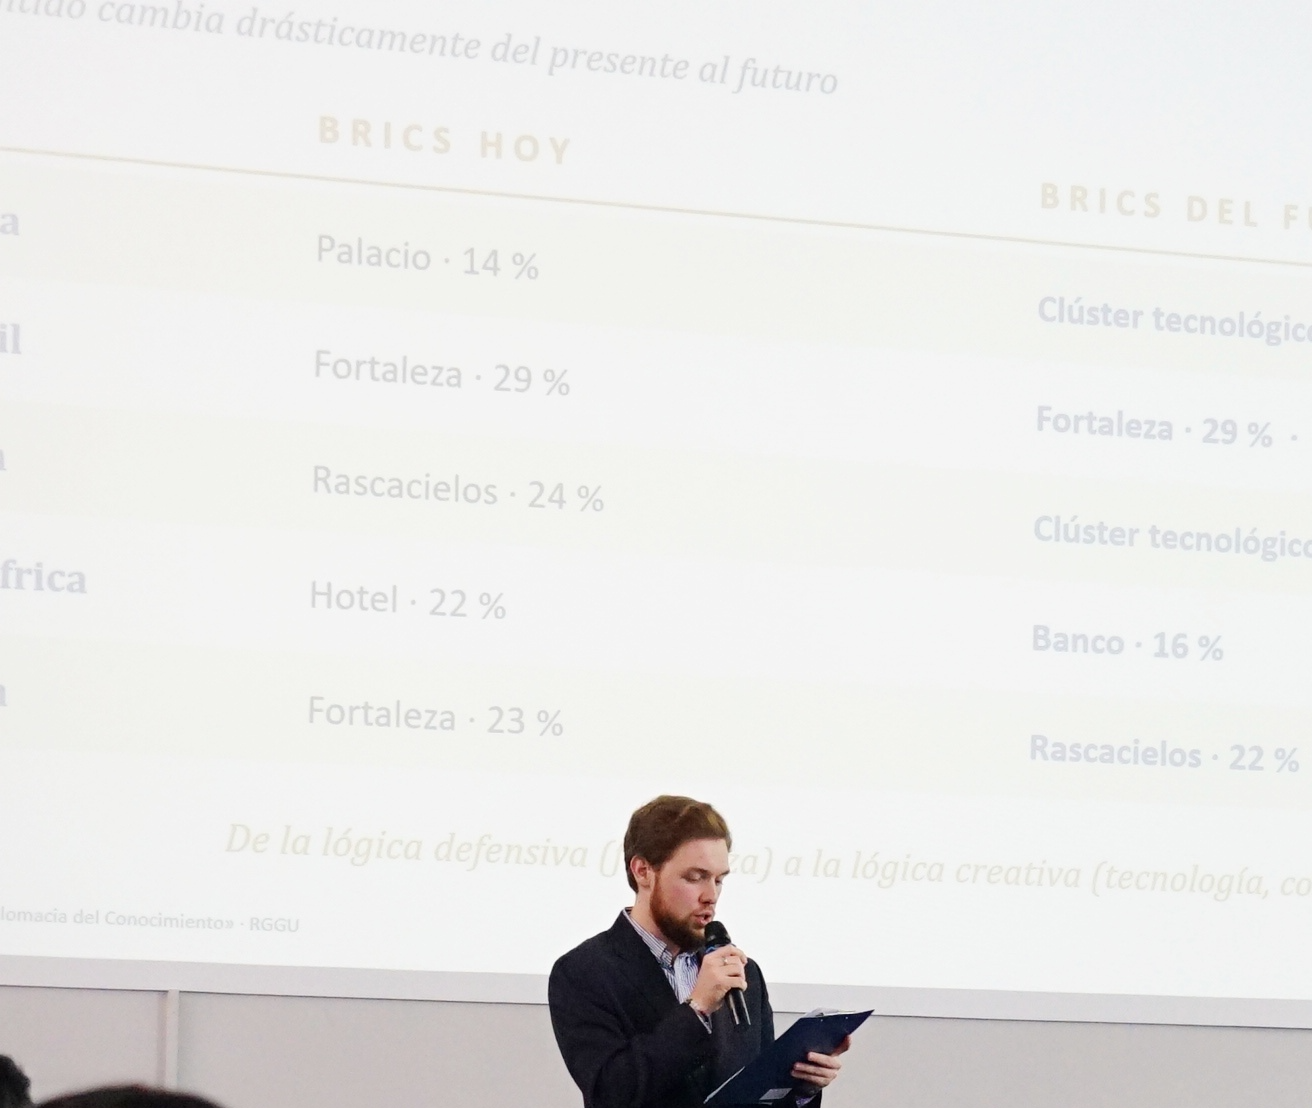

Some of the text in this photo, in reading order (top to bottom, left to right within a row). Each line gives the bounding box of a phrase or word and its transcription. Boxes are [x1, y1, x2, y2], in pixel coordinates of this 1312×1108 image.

[96, 0, 225, 35] cambia
[235, 5, 482, 61] drásticamente
[489, 31, 542, 66] del
[546, 45, 691, 81] presente
[697, 54, 731, 85] al
[731, 56, 839, 96] futuro
[317, 113, 571, 166] BRICS HOY
[1040, 181, 1163, 219] BRICS
[1186, 194, 1258, 228] DEL
[316, 233, 540, 281] Palacio 14 %
[1037, 295, 1145, 330] Clúster
[314, 348, 571, 397] Fortaleza 29 %
[1035, 404, 1174, 442] Fortaleza
[1201, 417, 1239, 446] 29
[1246, 421, 1274, 449] %
[312, 464, 605, 513] Rascacielos 24 %
[1033, 514, 1141, 548] Clúster
[310, 579, 507, 620] Hotel 22 %
[1031, 623, 1225, 662] Banco 16 %
[308, 694, 564, 737] Fortaleza 23 %
[1029, 734, 1301, 774] Rascacielos 22 %
[224, 821, 272, 855] De
[279, 823, 313, 856] la
[321, 825, 424, 868] lógica
[432, 831, 589, 873] defensiva
[782, 855, 804, 877] a
[811, 847, 842, 879] la
[850, 849, 946, 891] lógica
[954, 859, 1083, 889] creativa
[1090, 860, 1270, 903] (tecnología,
[71, 908, 101, 926] del
[103, 909, 235, 931] Conocimiento»
[248, 916, 301, 934] RGGU
